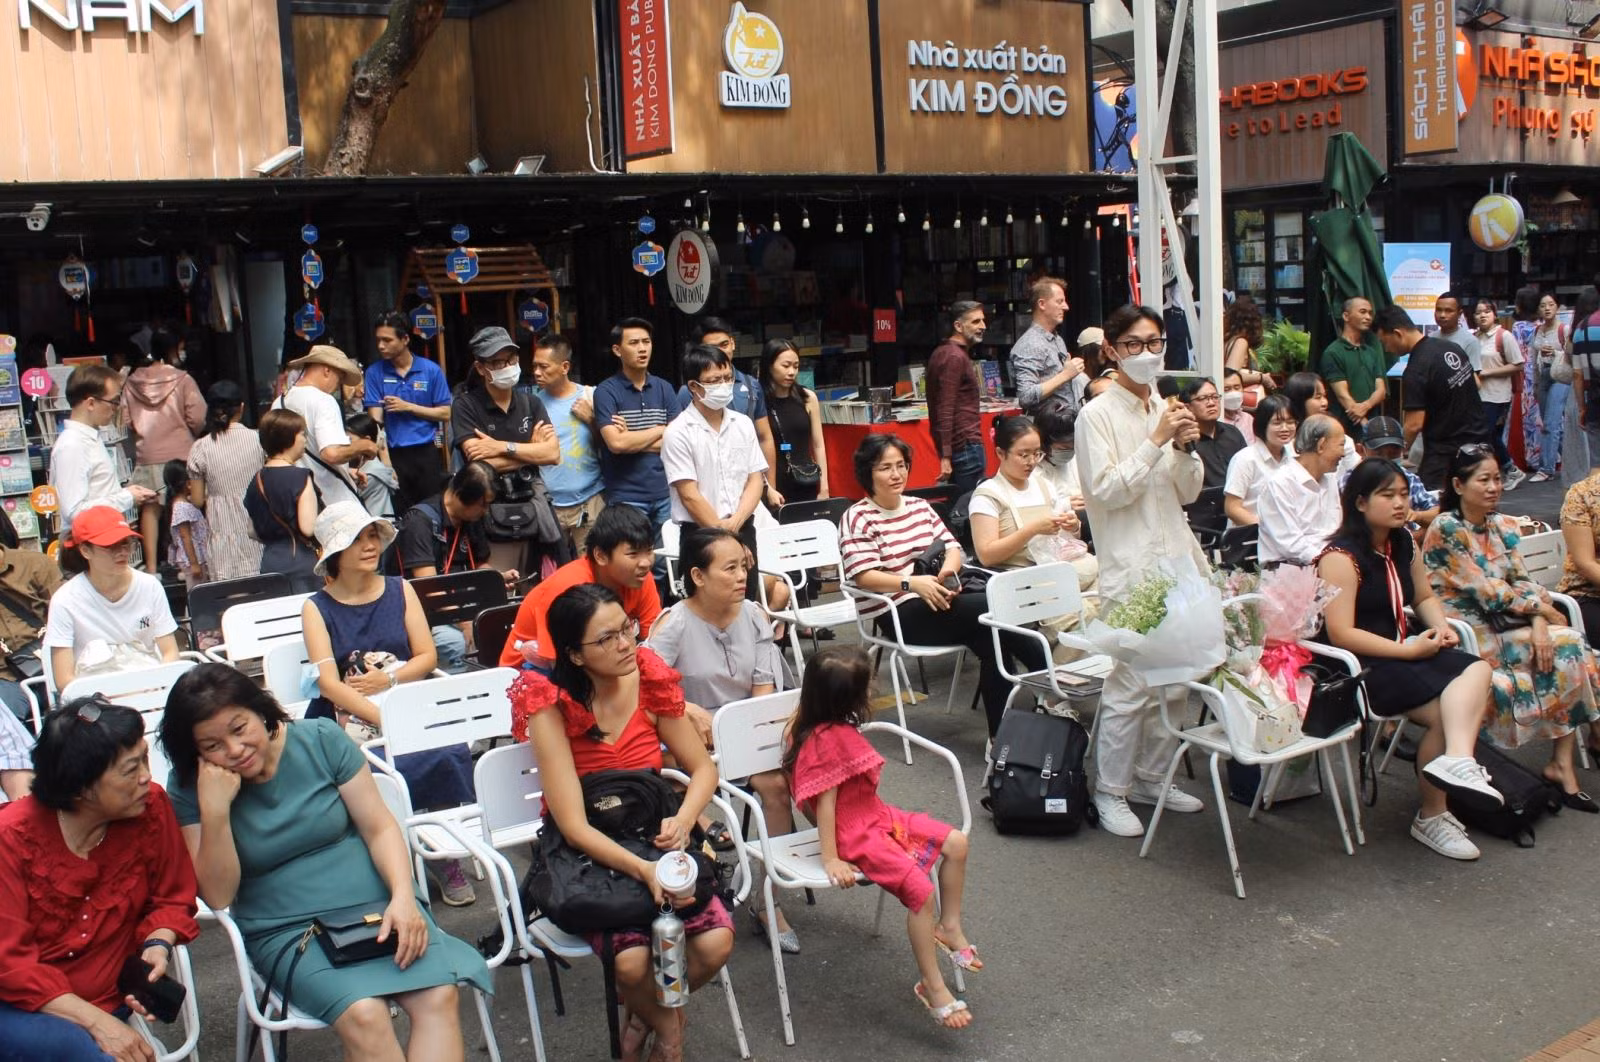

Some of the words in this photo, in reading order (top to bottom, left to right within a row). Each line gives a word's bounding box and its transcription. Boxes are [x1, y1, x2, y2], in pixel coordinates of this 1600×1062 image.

[627, 0, 641, 26] BẢ
[644, 0, 655, 34] PUB
[1409, 2, 1427, 63] THÁI
[629, 31, 643, 89] XUẤT
[646, 39, 658, 98] DONG
[908, 40, 959, 68] Nhà
[963, 40, 1017, 71] xuất
[1021, 45, 1067, 74] bản
[1434, 0, 1448, 116] THAIHABOO
[726, 75, 750, 102] KIM
[909, 79, 966, 112] KIM
[973, 73, 1068, 117] ĐỒNG
[1218, 65, 1369, 109] HABOOKS
[1411, 68, 1429, 140] SÁCH
[633, 94, 645, 141] NHÀ
[650, 104, 660, 138] KIM
[1248, 117, 1275, 137] to
[1279, 101, 1343, 133] Lead
[876, 319, 891, 330] 10%
[25, 376, 45, 390] -10
[33, 493, 56, 507] -20
